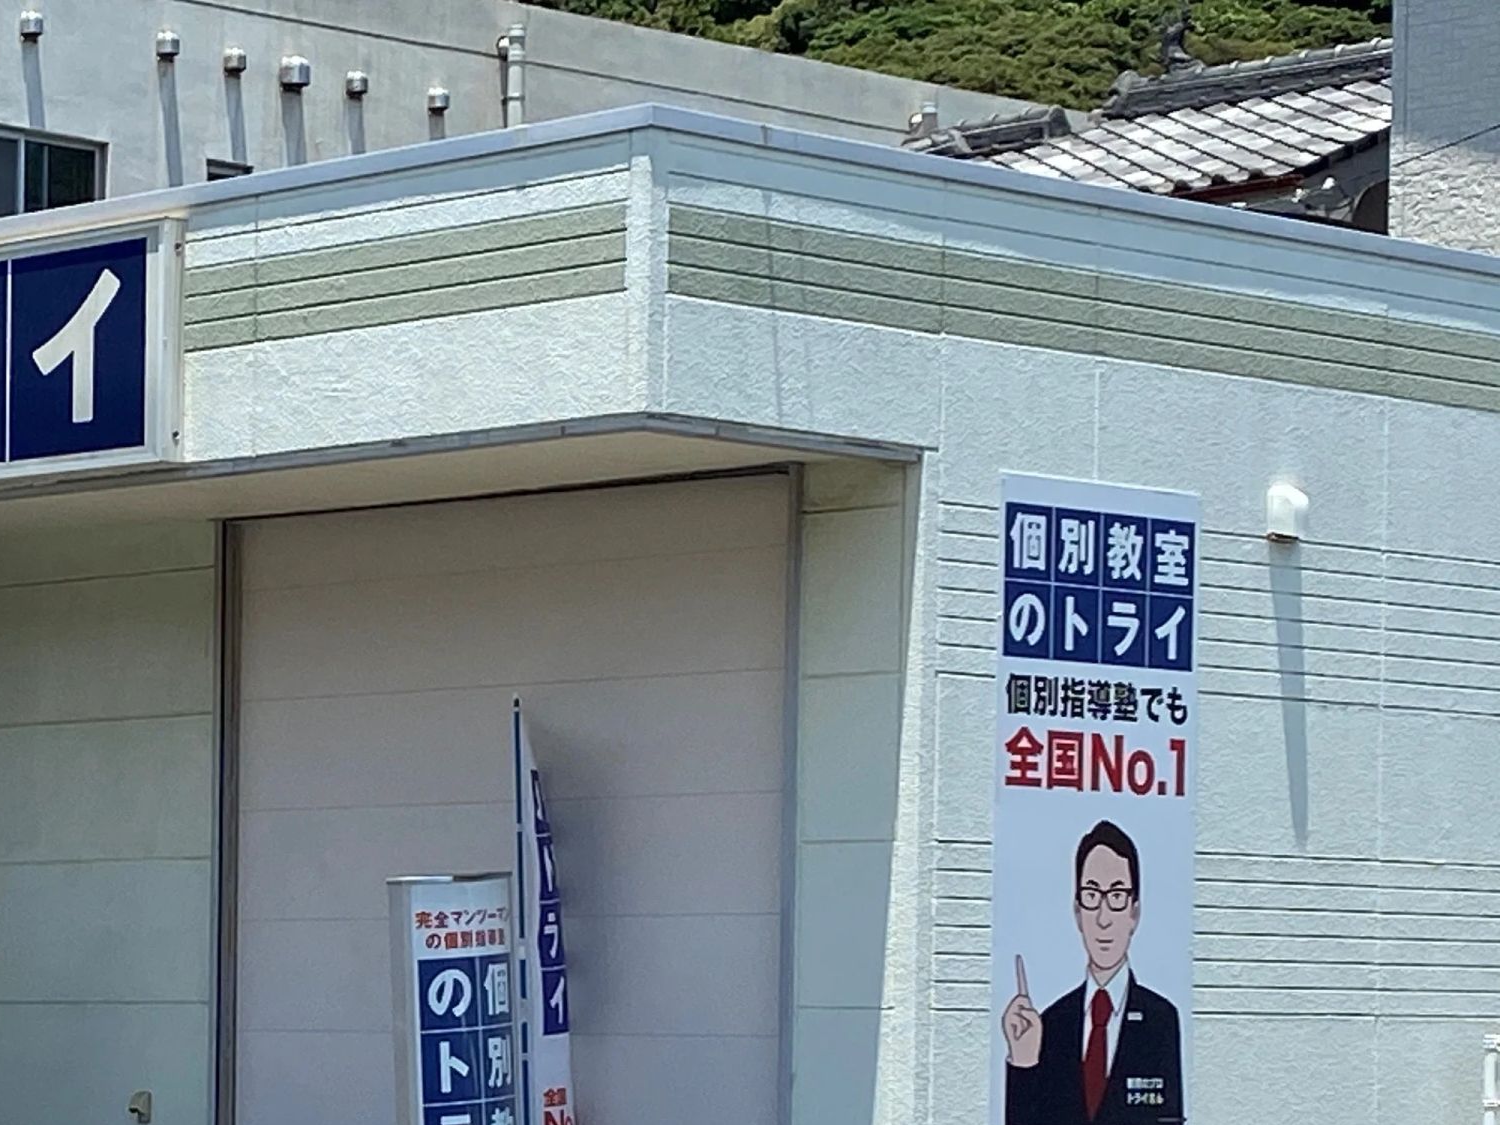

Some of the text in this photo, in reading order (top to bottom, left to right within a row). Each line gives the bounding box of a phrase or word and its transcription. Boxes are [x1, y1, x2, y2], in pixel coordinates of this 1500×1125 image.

[1009, 512, 1190, 587] 個別教室
[1008, 593, 1187, 661] のトライ
[1005, 673, 1188, 726] 個別指導塾でも
[1004, 726, 1187, 797] 全国No.1
